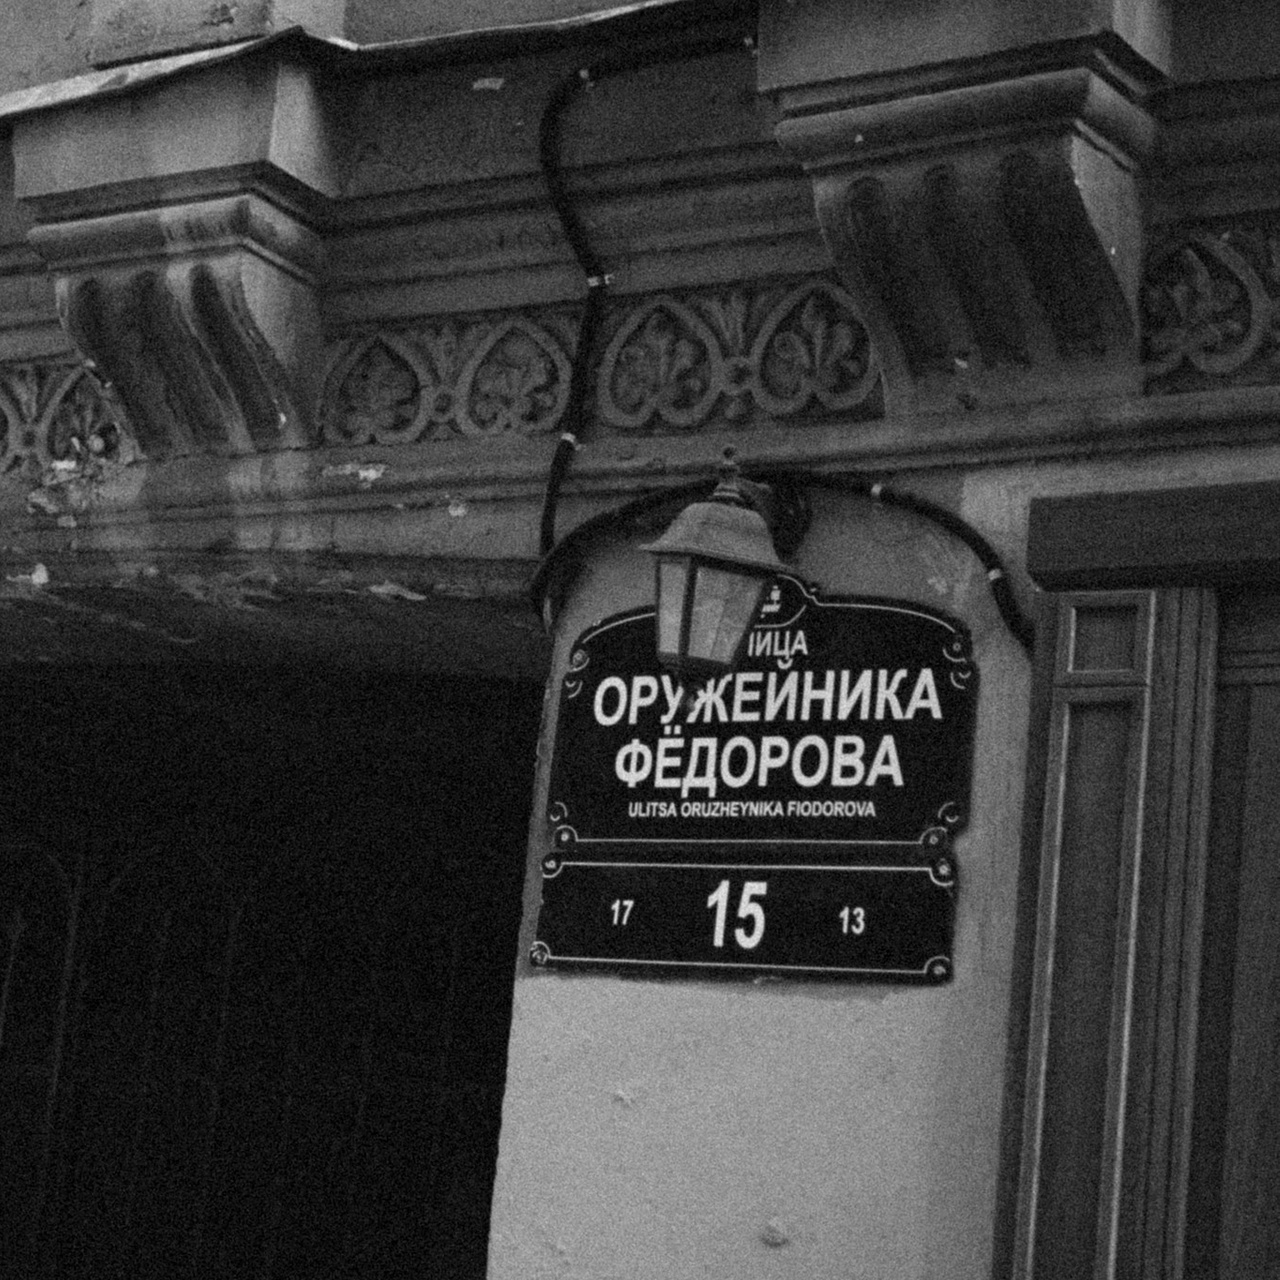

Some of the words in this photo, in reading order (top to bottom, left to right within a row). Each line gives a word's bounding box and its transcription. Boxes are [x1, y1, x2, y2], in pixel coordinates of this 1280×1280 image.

[747, 629, 809, 661] ИЦА
[593, 658, 943, 726] ОРУЖЕЙНИКА
[614, 724, 904, 799] ФЁДОРОВА
[628, 801, 678, 818] ULITSA
[680, 800, 784, 818] ORUZHEYNIKA
[786, 800, 876, 818] FIODOROVA
[610, 899, 635, 926] 17
[706, 879, 768, 950] 15
[839, 906, 866, 935] 13
